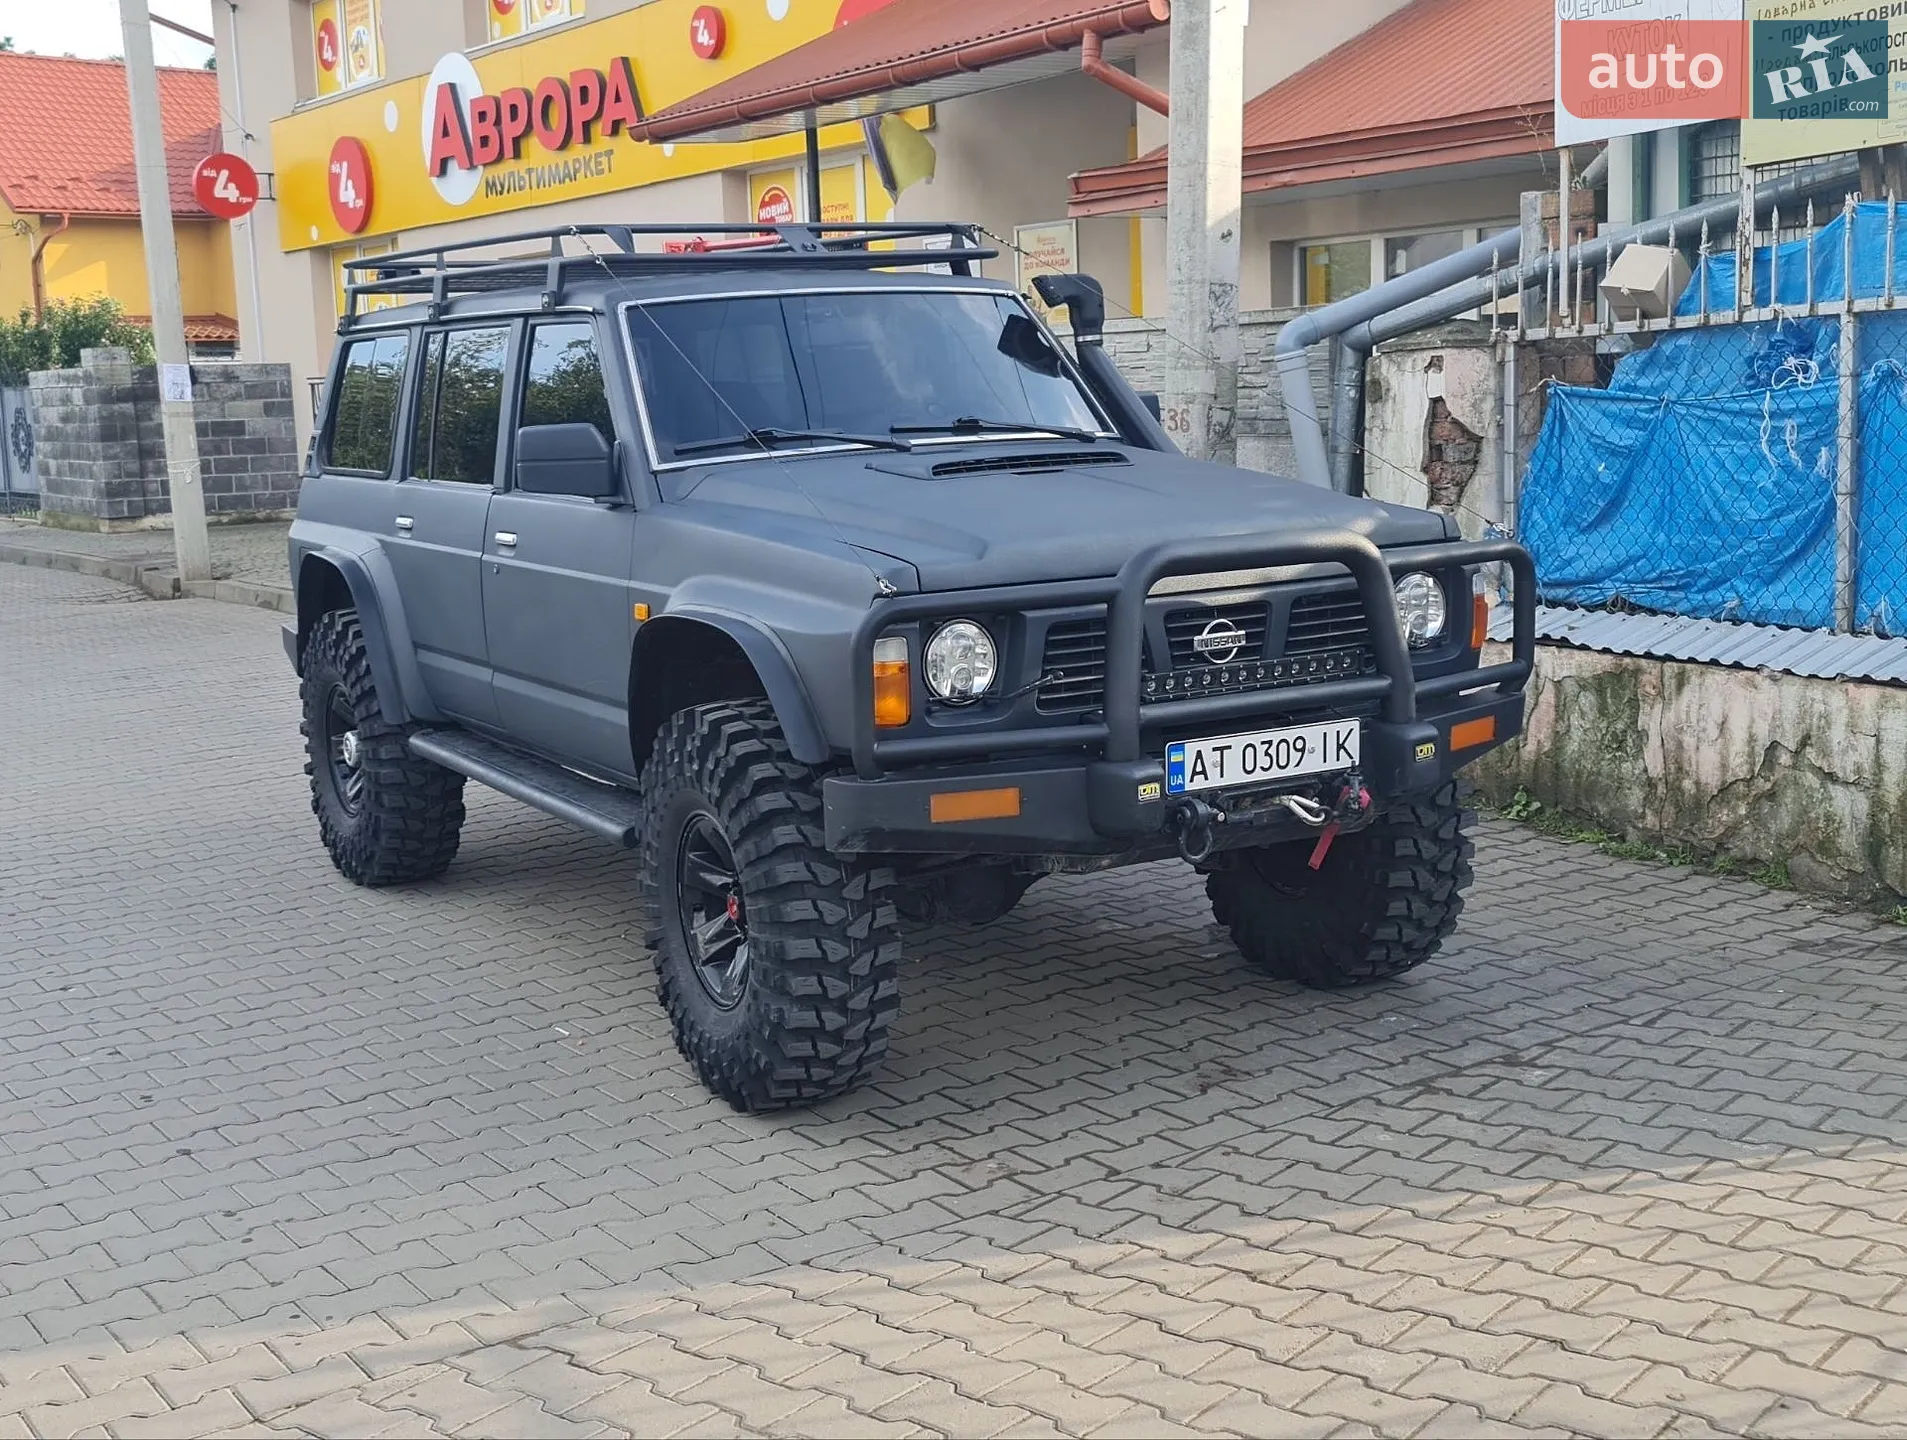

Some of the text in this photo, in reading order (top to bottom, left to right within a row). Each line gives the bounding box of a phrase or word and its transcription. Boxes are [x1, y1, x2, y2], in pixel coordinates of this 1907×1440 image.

[697, 18, 710, 46] 4
[1607, 14, 1683, 62] КУТОК
[429, 56, 645, 178] АВРОРА
[1581, 94, 1626, 118] місця
[1654, 82, 1675, 105] по
[1777, 94, 1848, 121] товарів
[213, 168, 240, 203] 4
[339, 160, 356, 208] 4
[485, 150, 614, 199] МУЛЬТИМАРКЕТ
[759, 197, 790, 221] НОВИЙ
[1167, 407, 1190, 433] 36
[1201, 634, 1243, 650] NISSAN
[1170, 728, 1354, 787] UA AT 0309 IK
